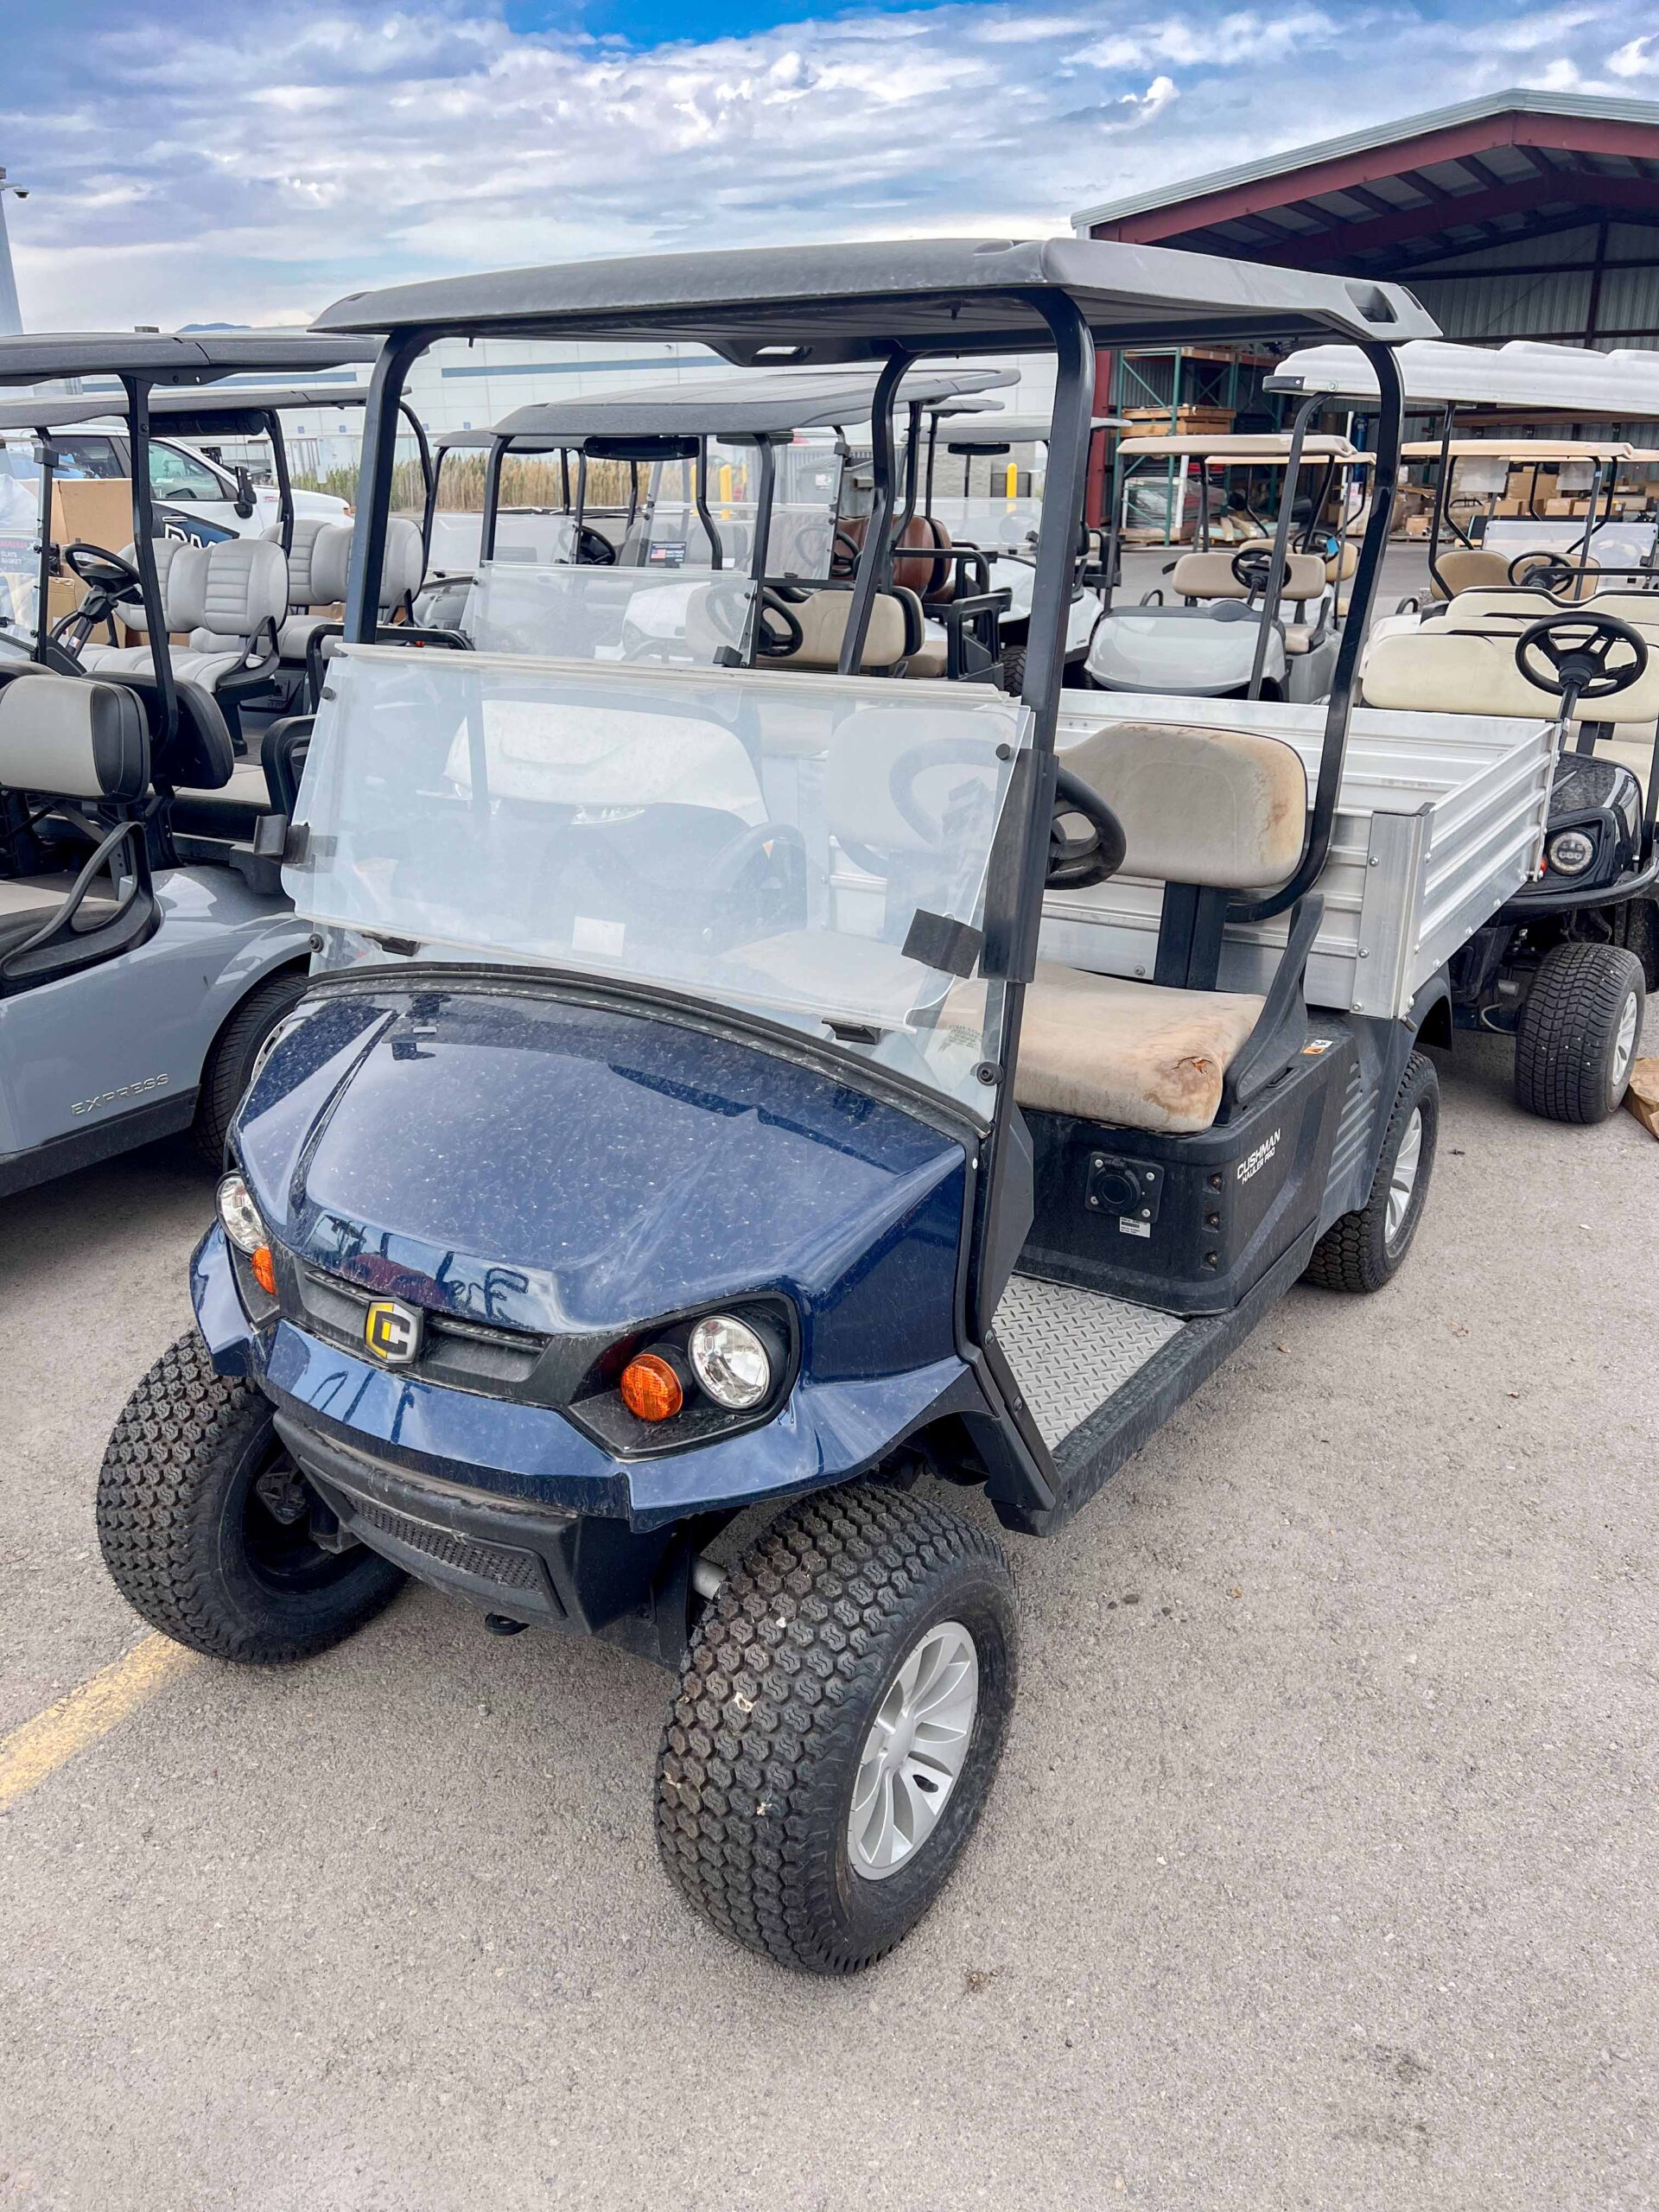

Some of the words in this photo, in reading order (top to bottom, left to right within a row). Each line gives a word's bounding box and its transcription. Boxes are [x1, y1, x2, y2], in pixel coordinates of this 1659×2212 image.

[71, 1073, 169, 1116] EXPRESS
[1236, 1128, 1281, 1179] CUSHMAN
[1242, 1157, 1264, 1185] HAULER
[1264, 1146, 1275, 1163] PRO
